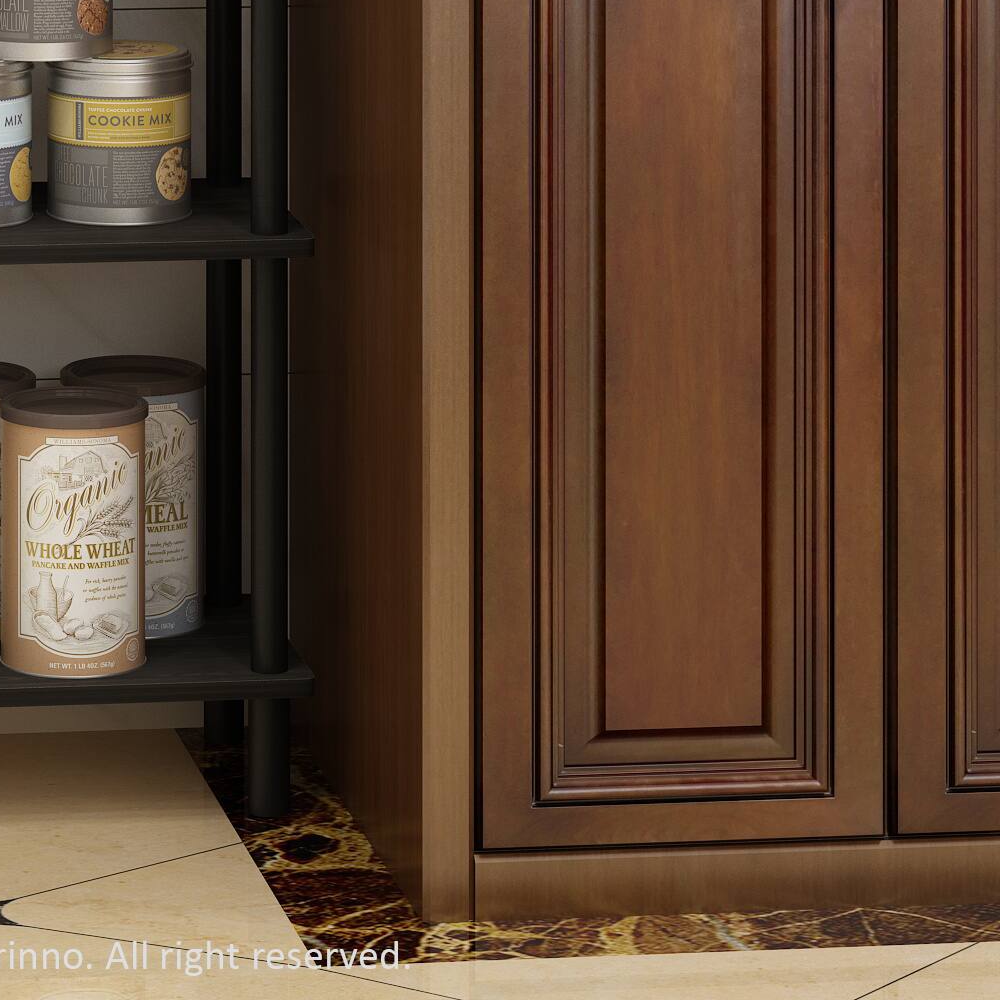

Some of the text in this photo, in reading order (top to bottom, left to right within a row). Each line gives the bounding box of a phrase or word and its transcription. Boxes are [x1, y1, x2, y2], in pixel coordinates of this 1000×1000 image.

[4, 113, 23, 128] MIX
[88, 112, 172, 127] COOKIE MIX
[26, 460, 126, 536] Organic
[146, 524, 175, 533] WAFFLE
[25, 540, 82, 560] WHOLE
[85, 537, 136, 560] WHEAT
[31, 560, 67, 570] PANCAKE
[86, 560, 117, 570] WAFFLE
[116, 558, 130, 566] MIX
